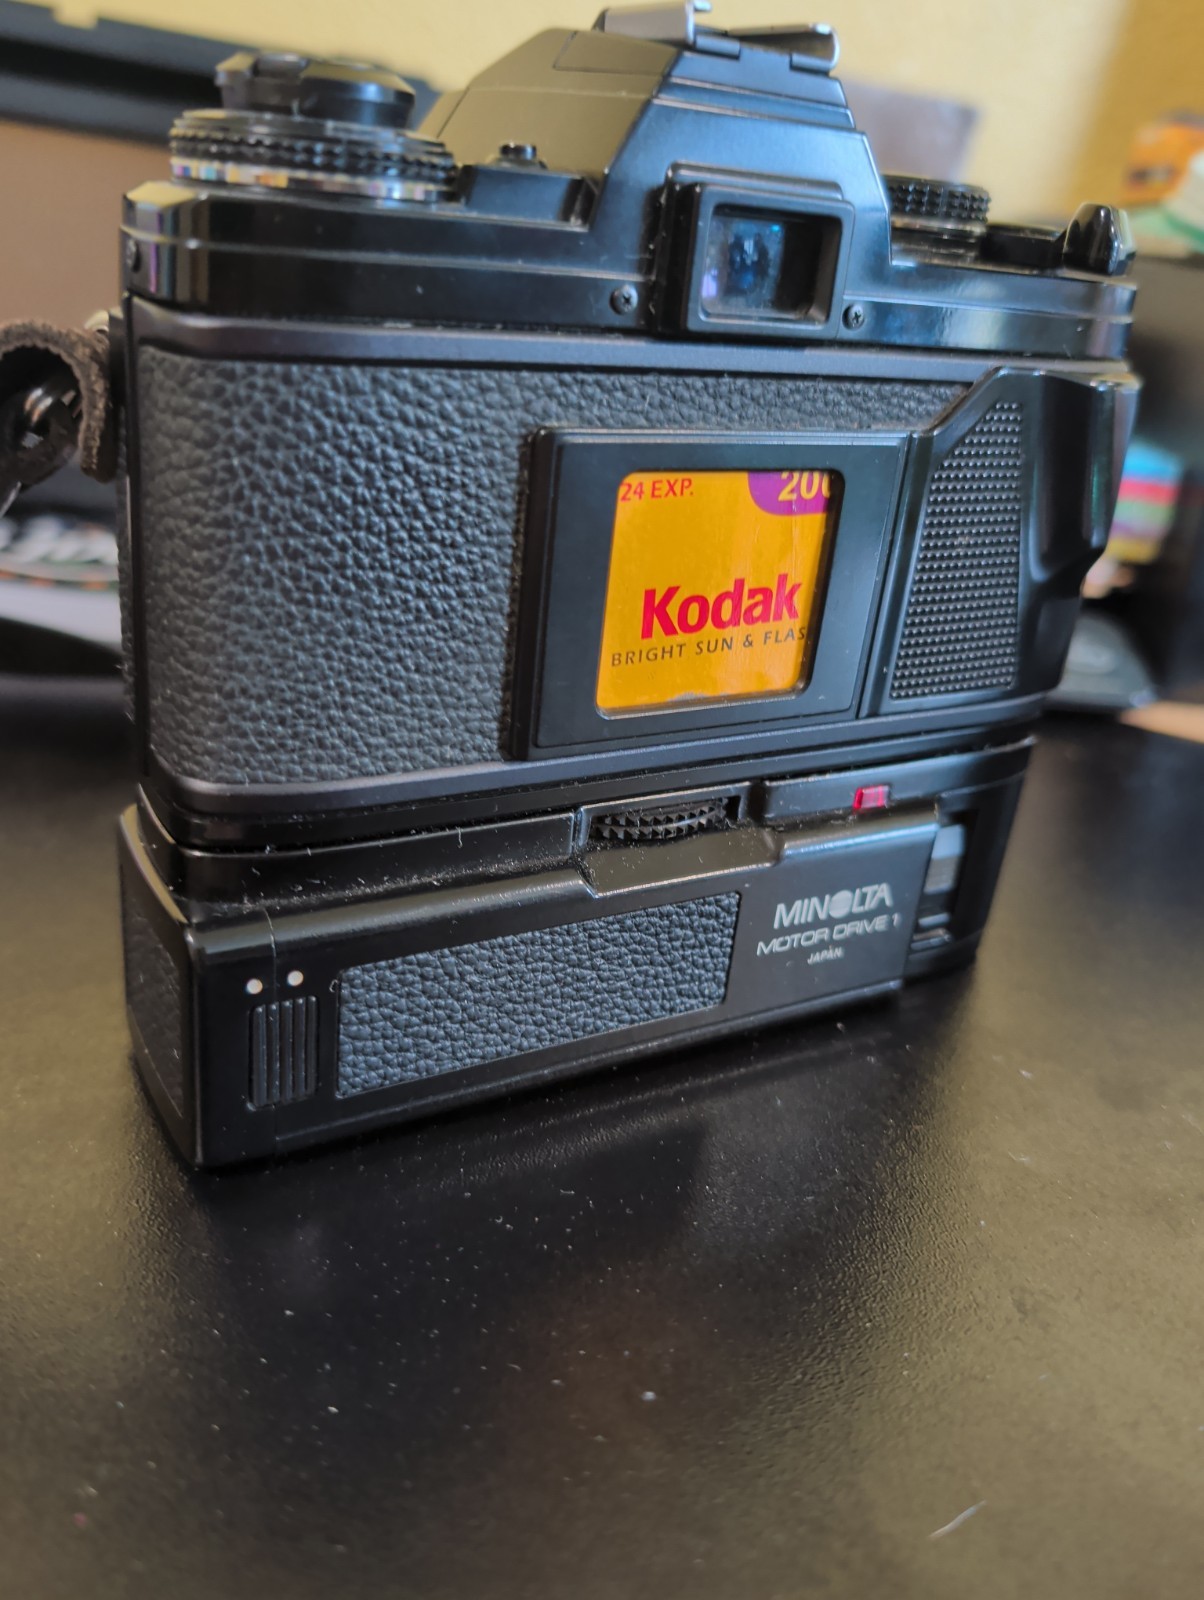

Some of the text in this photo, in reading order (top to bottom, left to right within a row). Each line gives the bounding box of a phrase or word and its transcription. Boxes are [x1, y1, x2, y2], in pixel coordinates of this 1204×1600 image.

[620, 477, 695, 502] 24 EXP.
[641, 573, 803, 640] Kodak
[611, 627, 806, 667] BRIGHT SUN & FLAS
[773, 882, 893, 929] MINOLTA
[756, 912, 902, 956] MOTOR DRIVE 1
[807, 946, 843, 965] JAPAN
